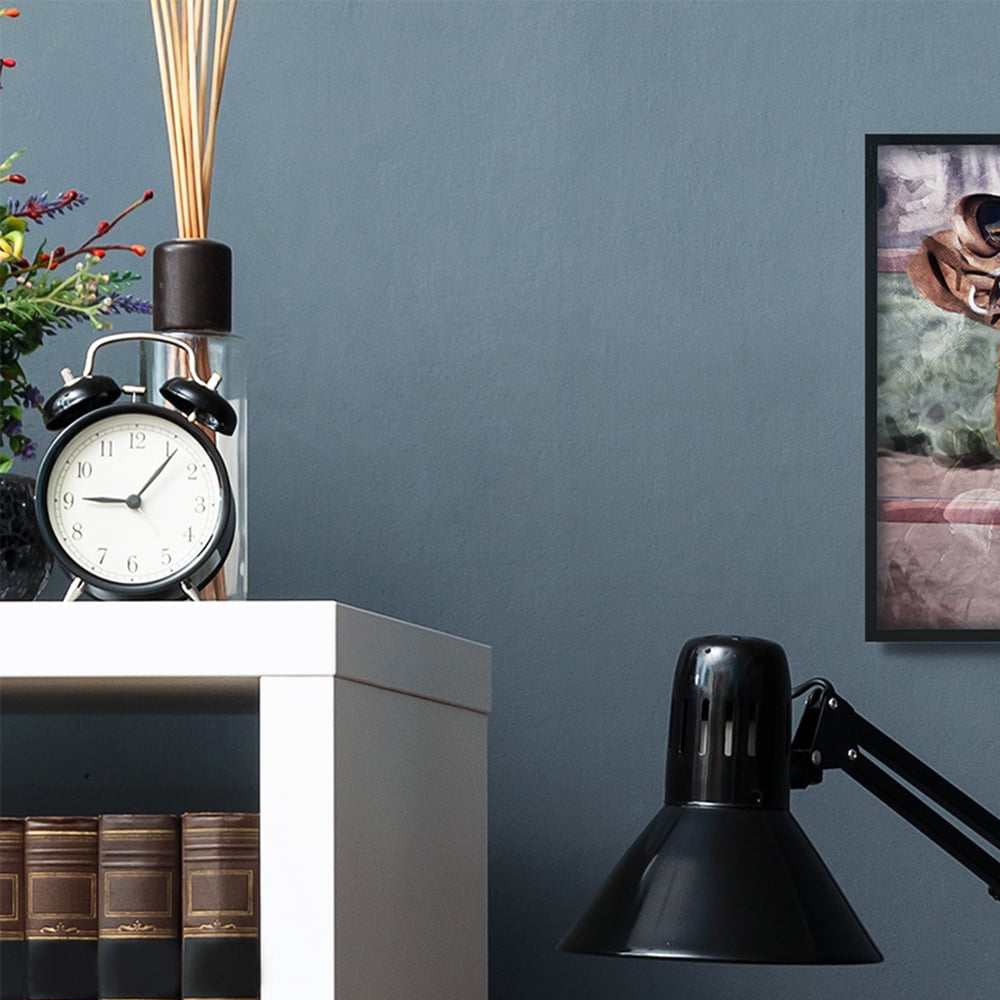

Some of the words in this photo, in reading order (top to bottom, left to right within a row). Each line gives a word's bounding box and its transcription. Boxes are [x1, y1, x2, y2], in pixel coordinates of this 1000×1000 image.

[100, 440, 113, 457] 11
[129, 432, 146, 449] 12
[165, 441, 172, 458] 1
[77, 462, 93, 478] 10
[186, 463, 198, 480] 2
[63, 492, 74, 510] 9
[194, 496, 206, 513] 3
[71, 522, 83, 540] 8
[183, 526, 195, 542] 4
[97, 548, 108, 565] 7
[127, 555, 138, 573] 6
[161, 548, 172, 565] 5
